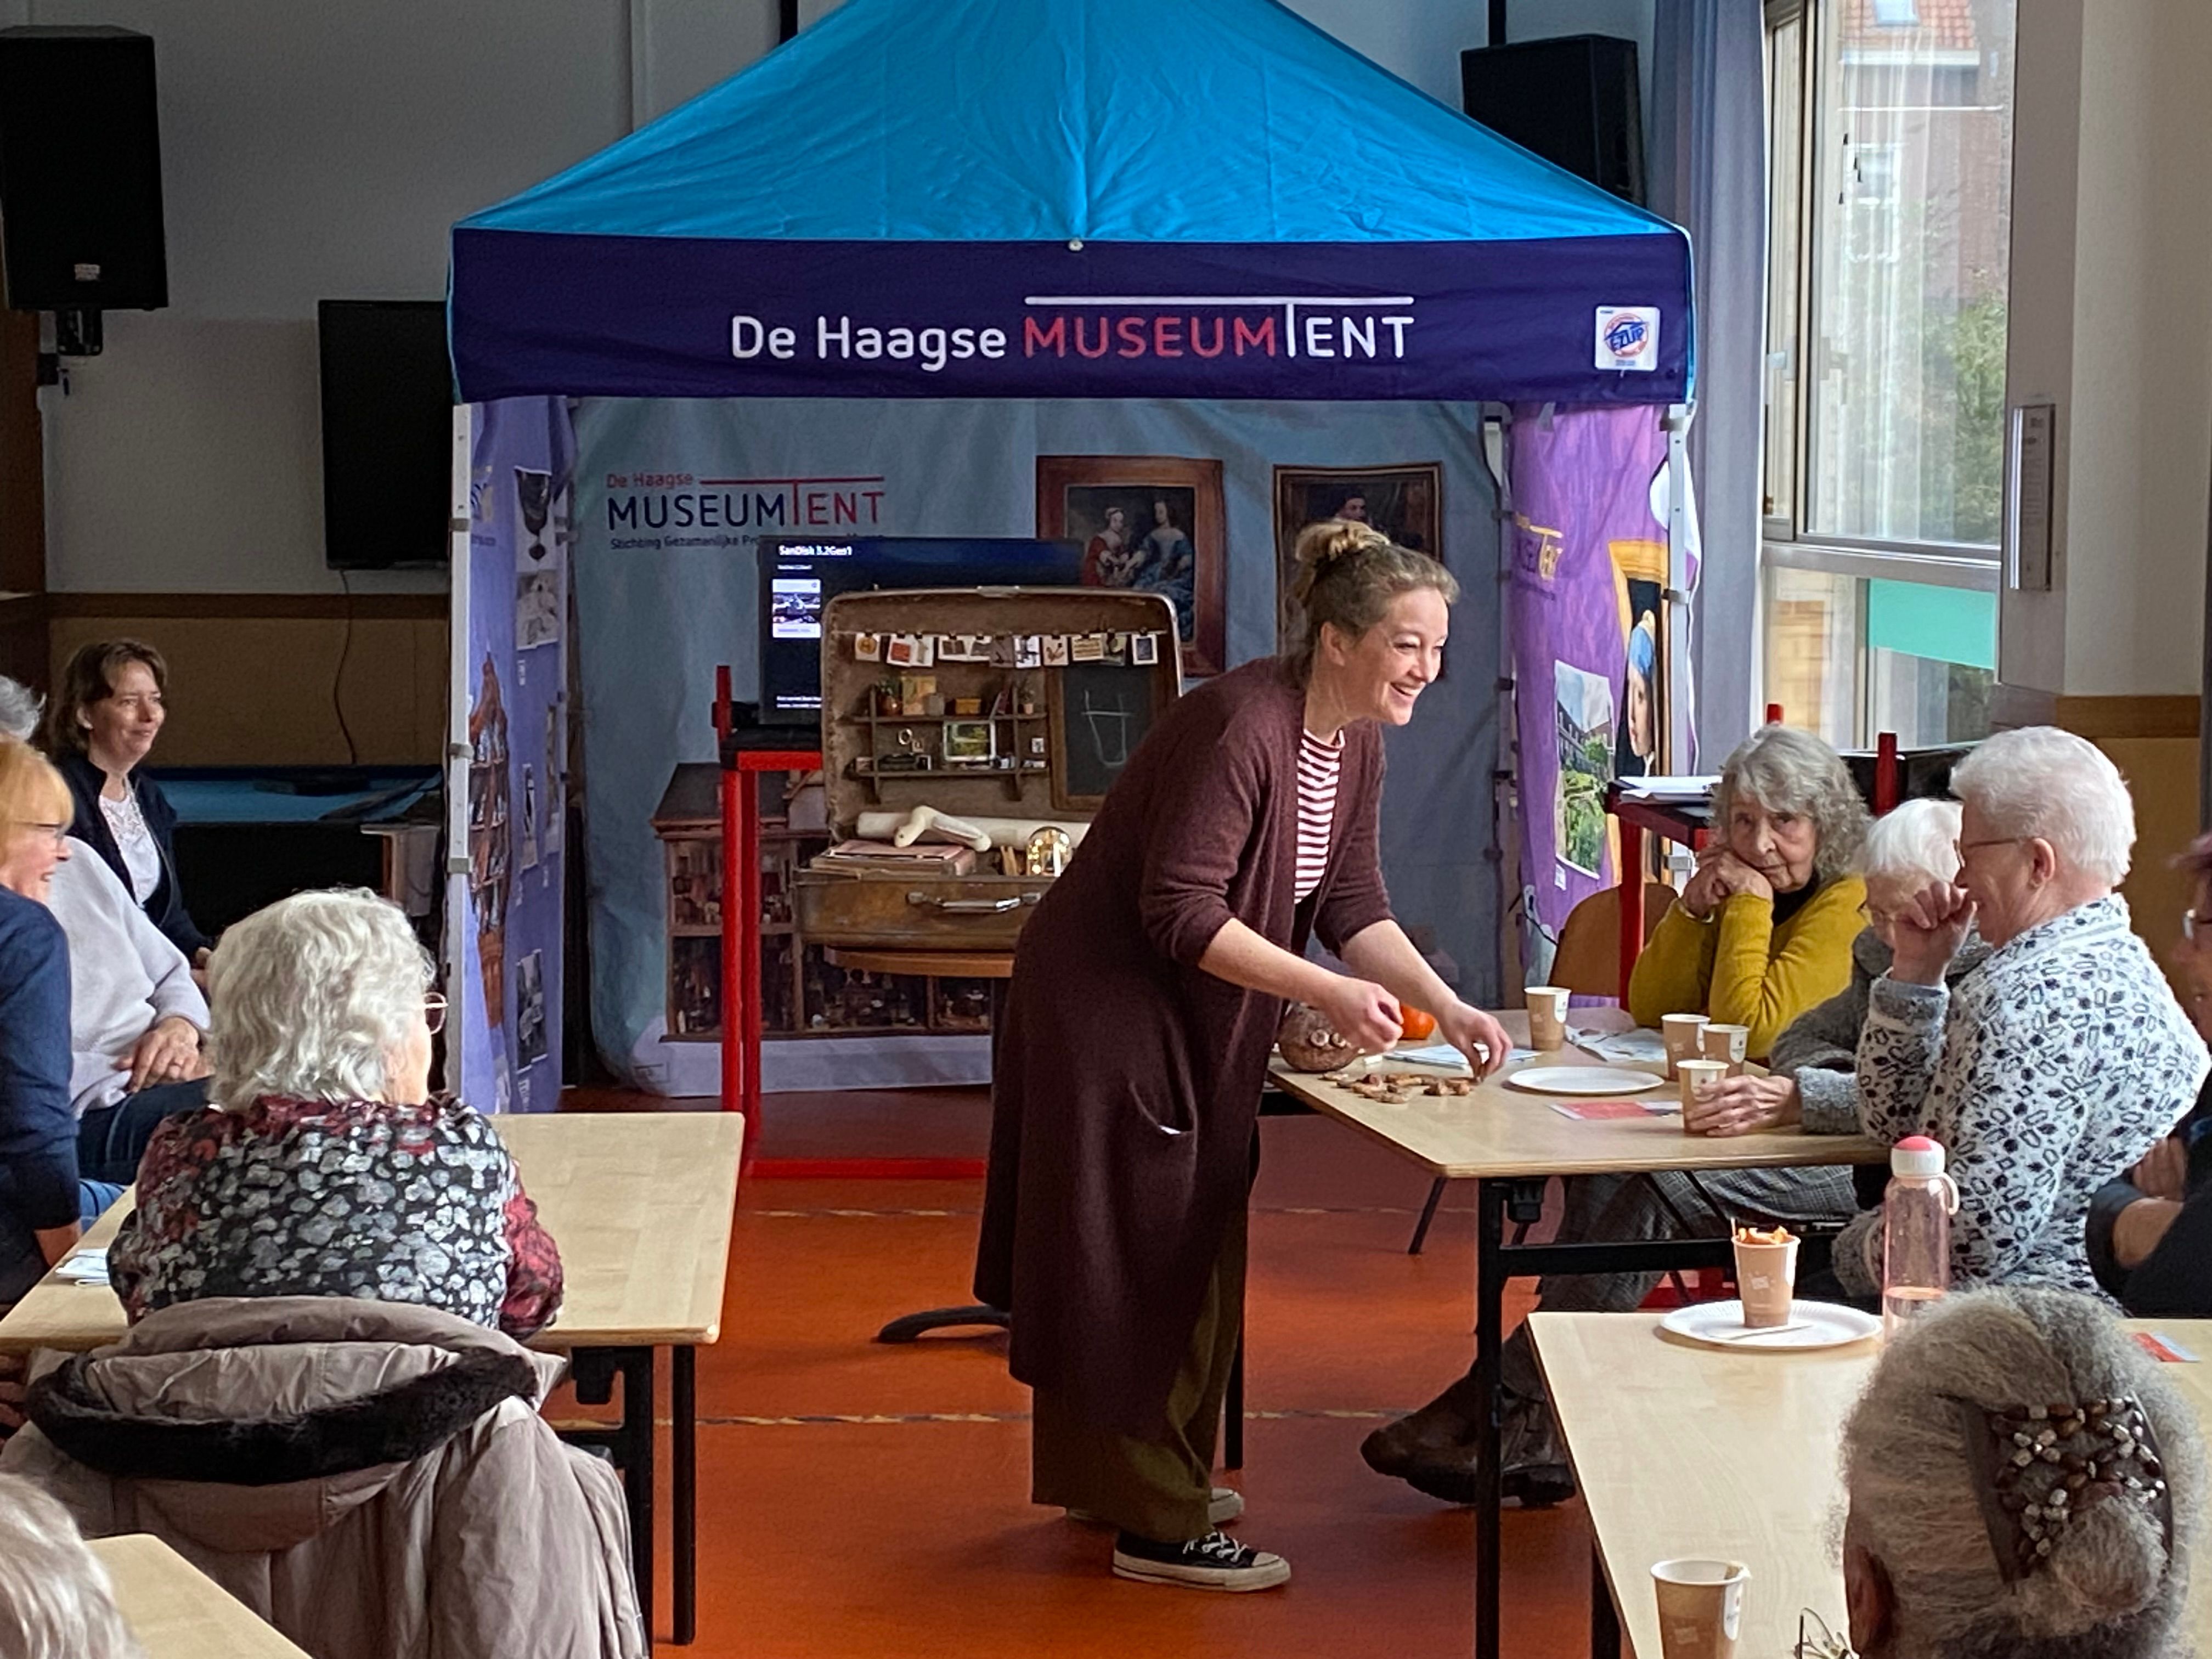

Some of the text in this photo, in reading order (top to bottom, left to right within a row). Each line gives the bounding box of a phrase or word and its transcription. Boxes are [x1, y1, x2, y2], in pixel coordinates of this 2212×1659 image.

[732, 315, 795, 358] De
[817, 315, 1007, 371] Haagse
[606, 472, 693, 489] De Haagse
